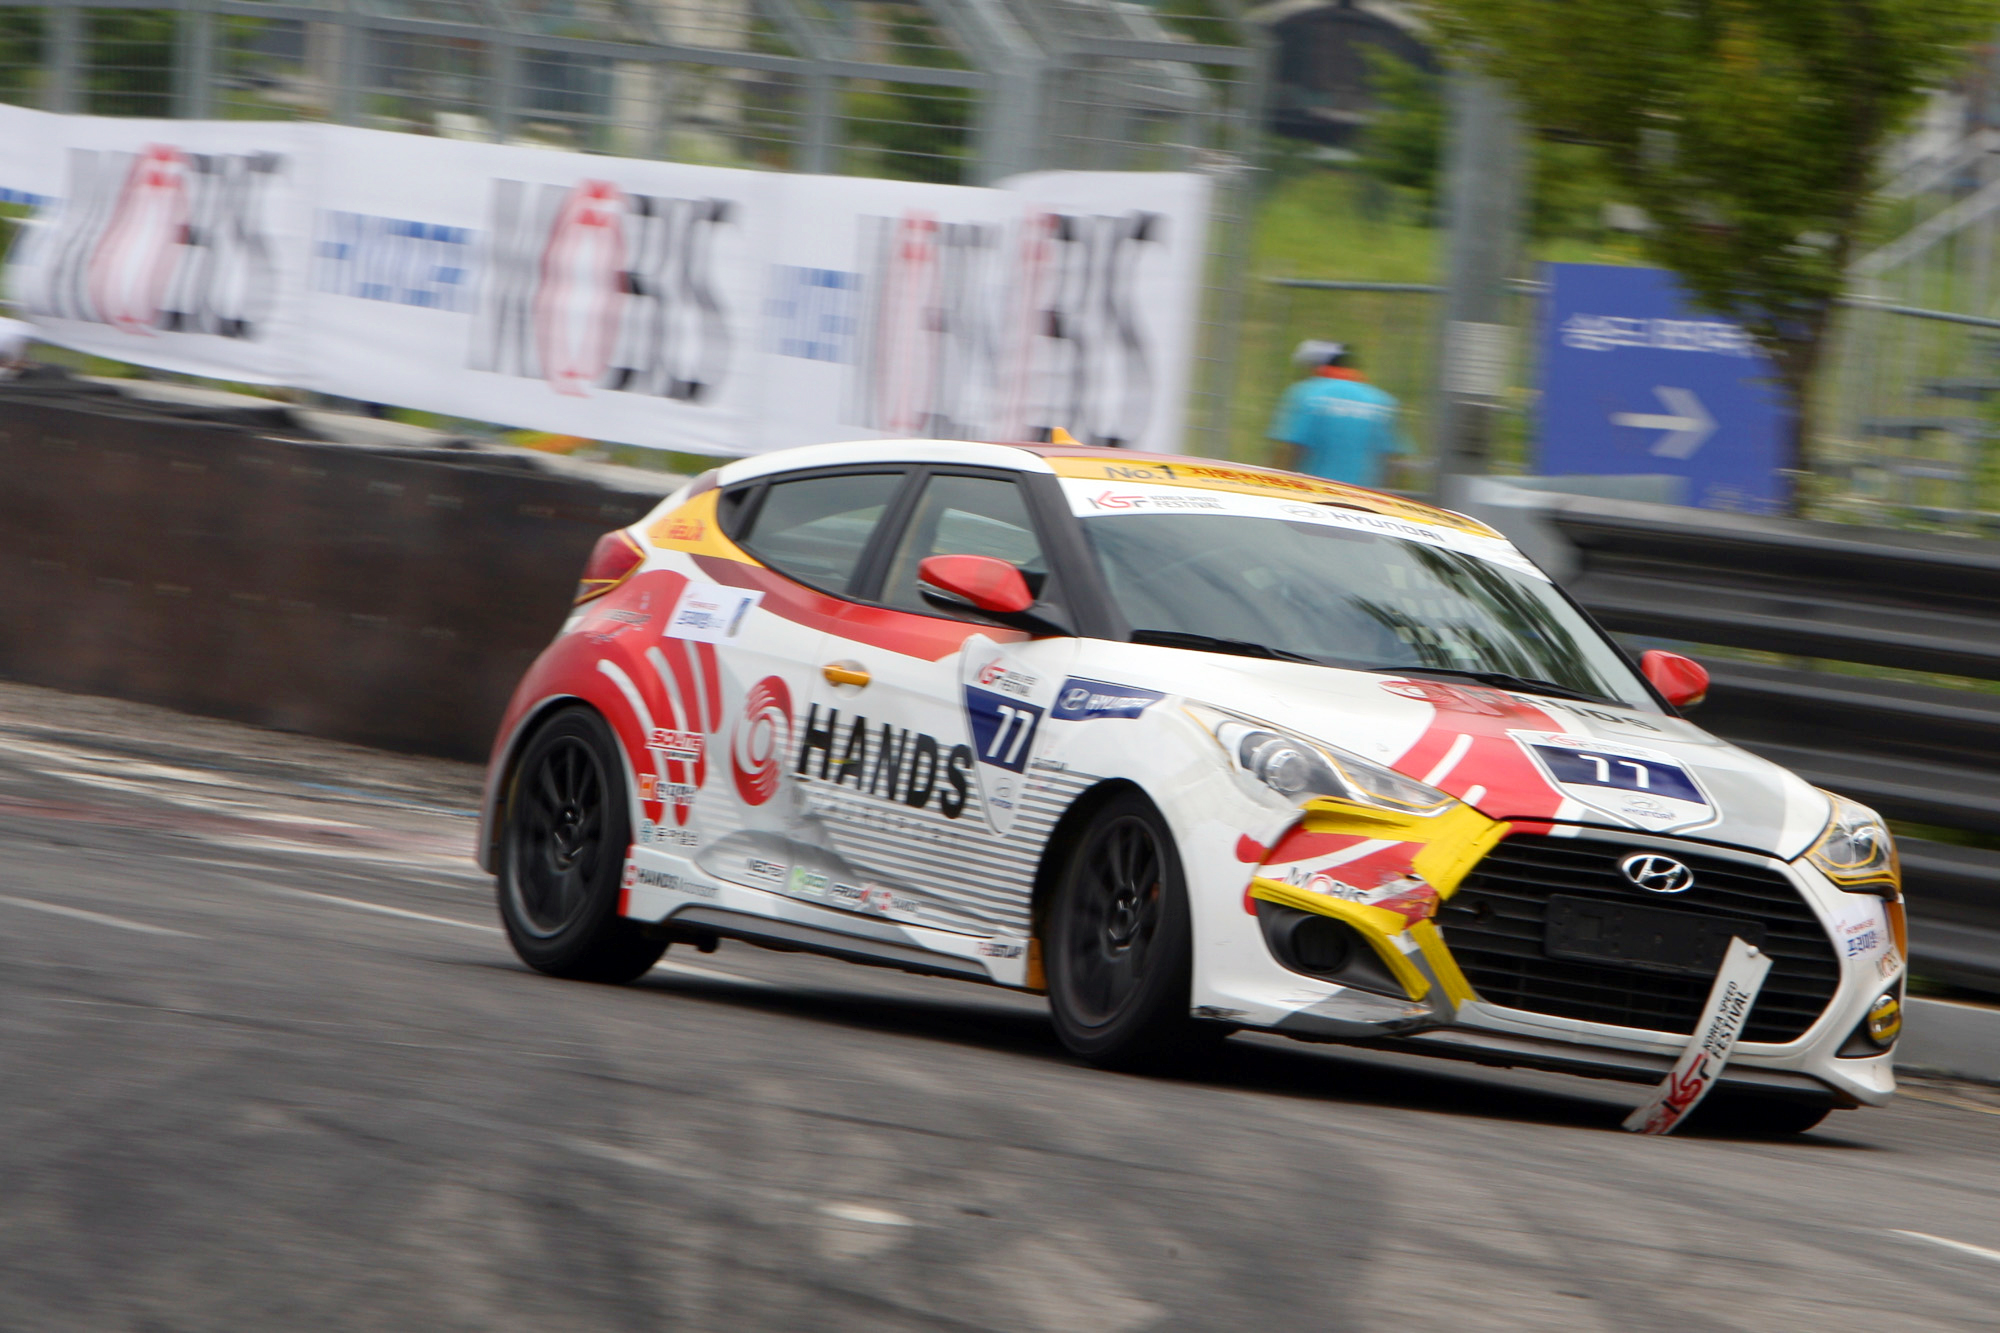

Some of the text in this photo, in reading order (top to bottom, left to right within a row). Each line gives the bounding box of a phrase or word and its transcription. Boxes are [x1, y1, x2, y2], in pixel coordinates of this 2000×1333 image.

[1103, 465, 1179, 480] No.1
[1331, 511, 1446, 542] HYUNDAI
[797, 702, 973, 819] HANDS
[986, 704, 1035, 765] 77
[1578, 754, 1650, 789] 77
[1711, 991, 1751, 1060] FESTIVAL
[1661, 1053, 1712, 1115] KSF
